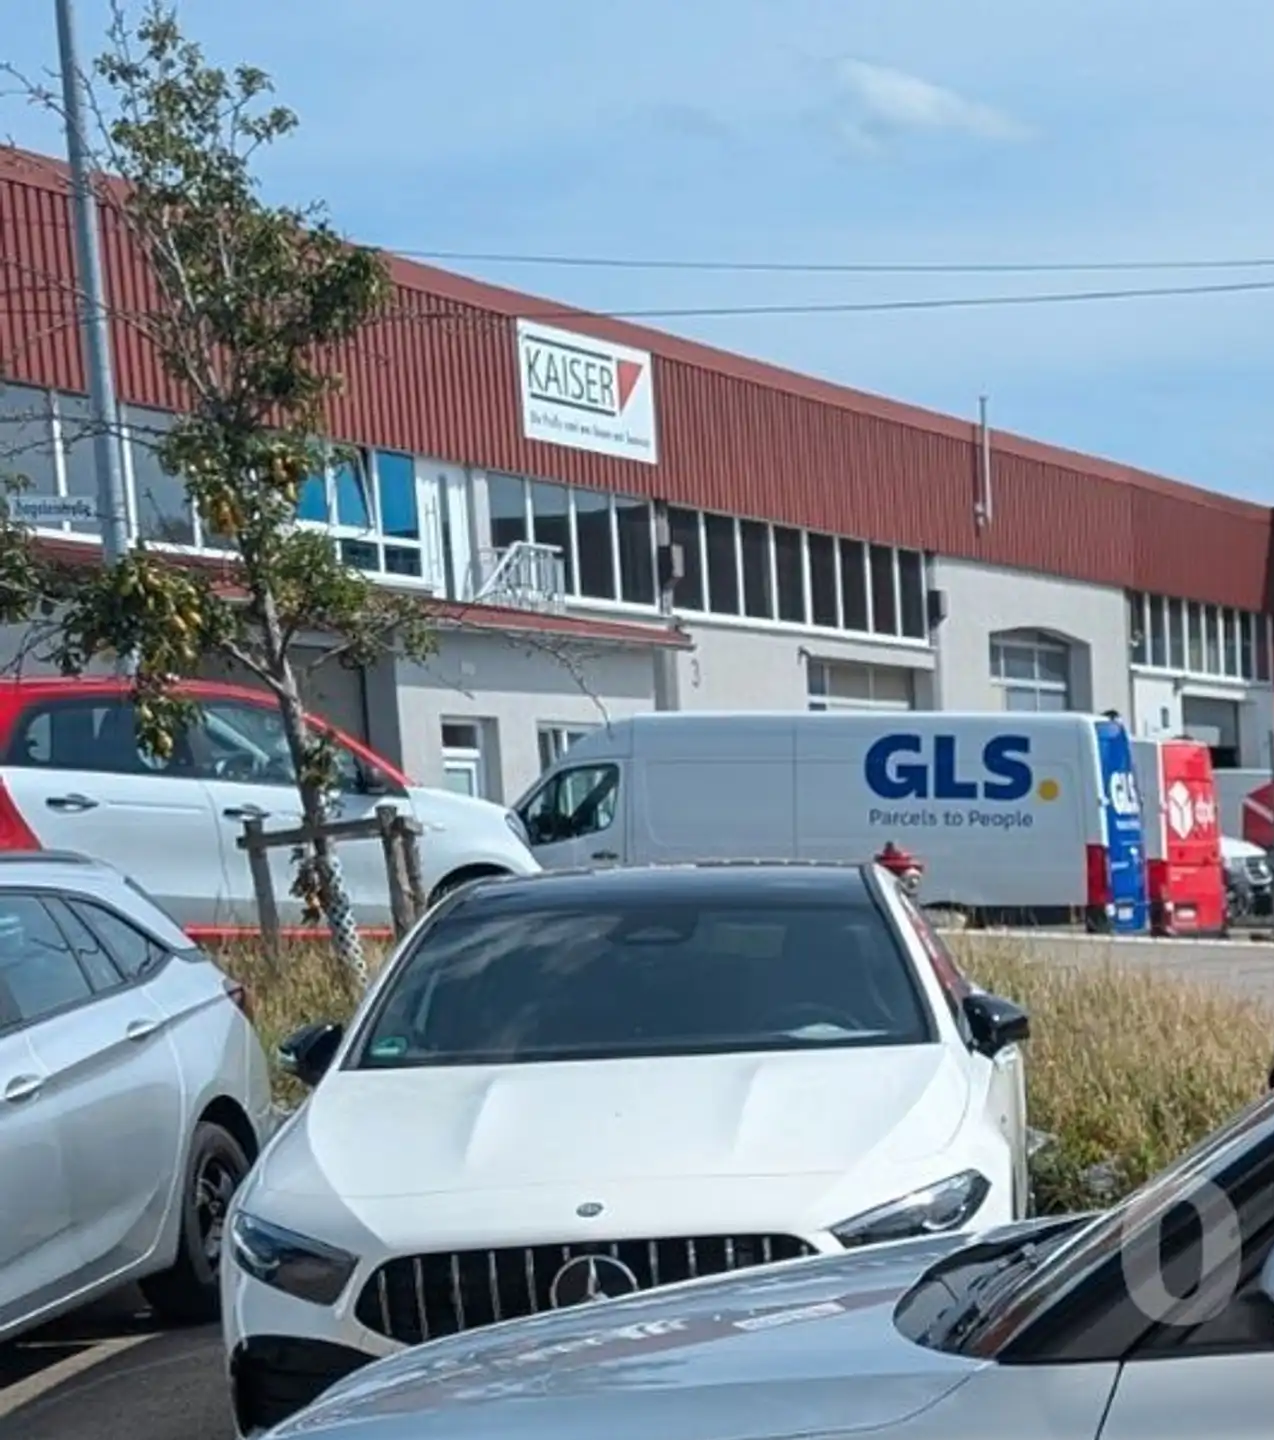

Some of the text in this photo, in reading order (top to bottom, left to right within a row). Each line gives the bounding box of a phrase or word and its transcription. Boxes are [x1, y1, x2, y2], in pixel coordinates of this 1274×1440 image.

[524, 345, 616, 409] KAISER
[868, 808, 1034, 831] Parcels to People
